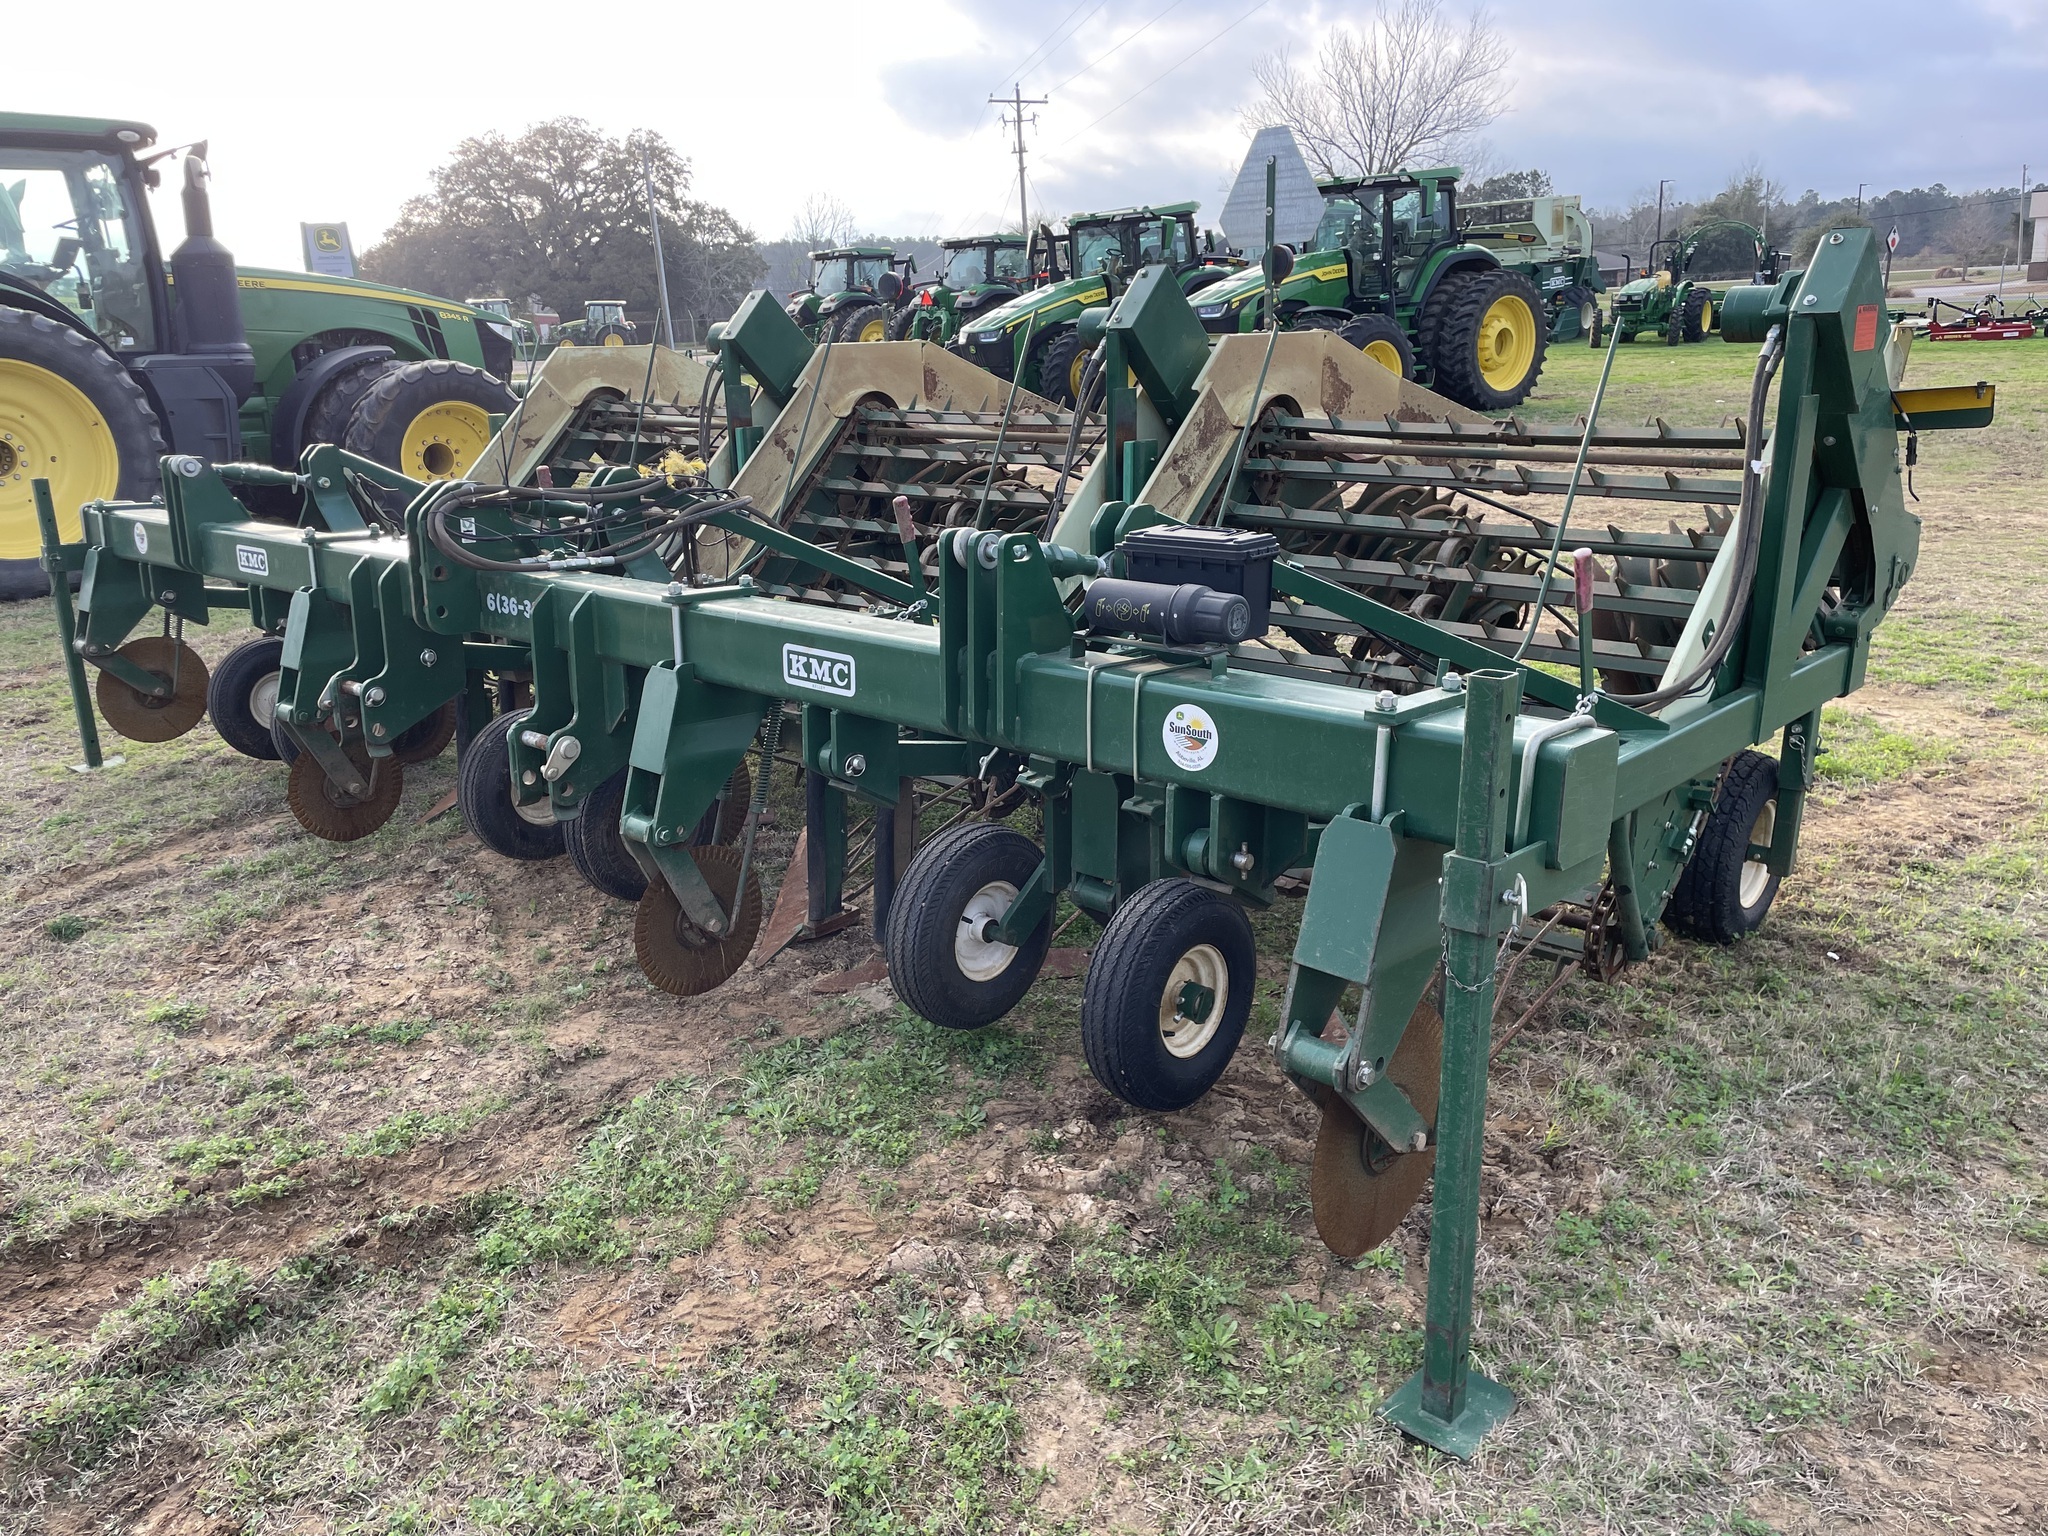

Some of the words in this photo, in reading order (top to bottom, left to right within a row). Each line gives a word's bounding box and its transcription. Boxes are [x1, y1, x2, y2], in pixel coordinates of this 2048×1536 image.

[1332, 267, 1346, 275] DEERE
[238, 280, 266, 288] EERE
[462, 315, 470, 323] R
[239, 551, 266, 570] KMC
[486, 592, 532, 619] 6(36-3
[789, 653, 849, 687] KMC
[1169, 721, 1212, 740] SunSouth
